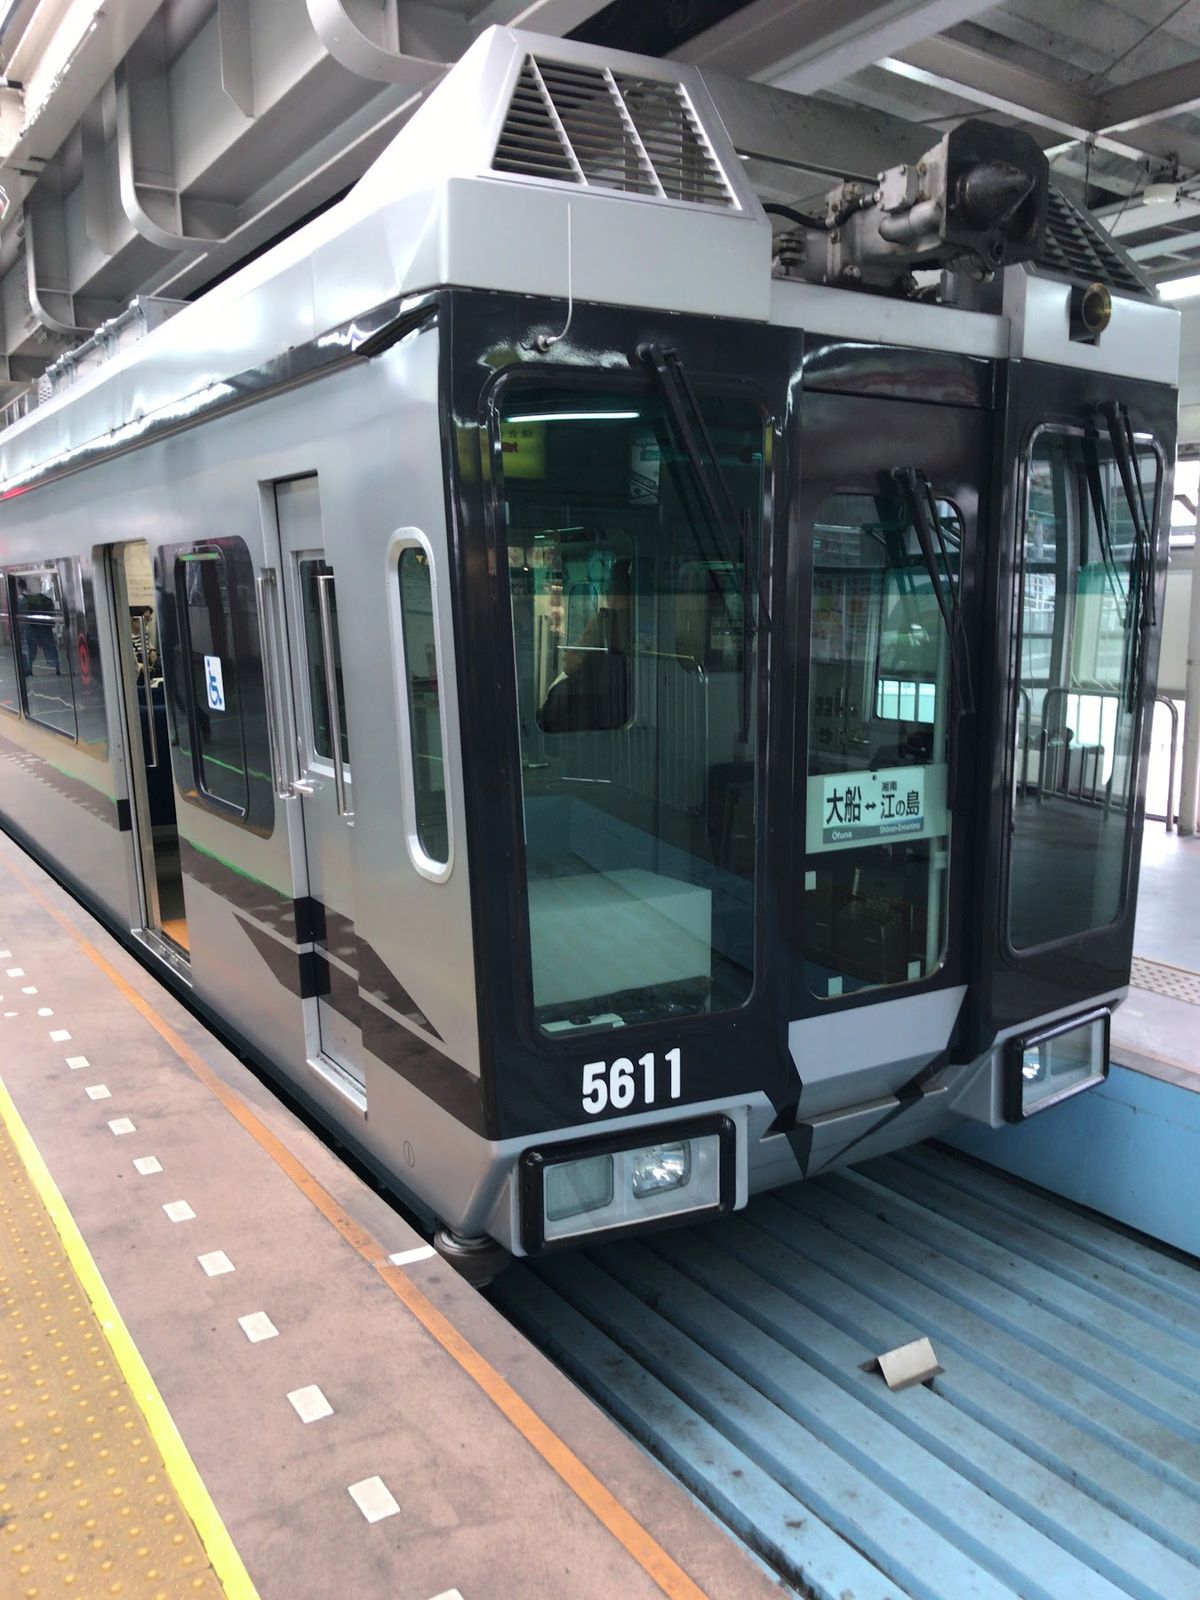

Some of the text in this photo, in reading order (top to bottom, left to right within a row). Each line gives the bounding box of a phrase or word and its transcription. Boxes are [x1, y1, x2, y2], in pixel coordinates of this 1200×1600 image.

[826, 785, 920, 824] 大船 江の島
[582, 1047, 681, 1115] 5611
